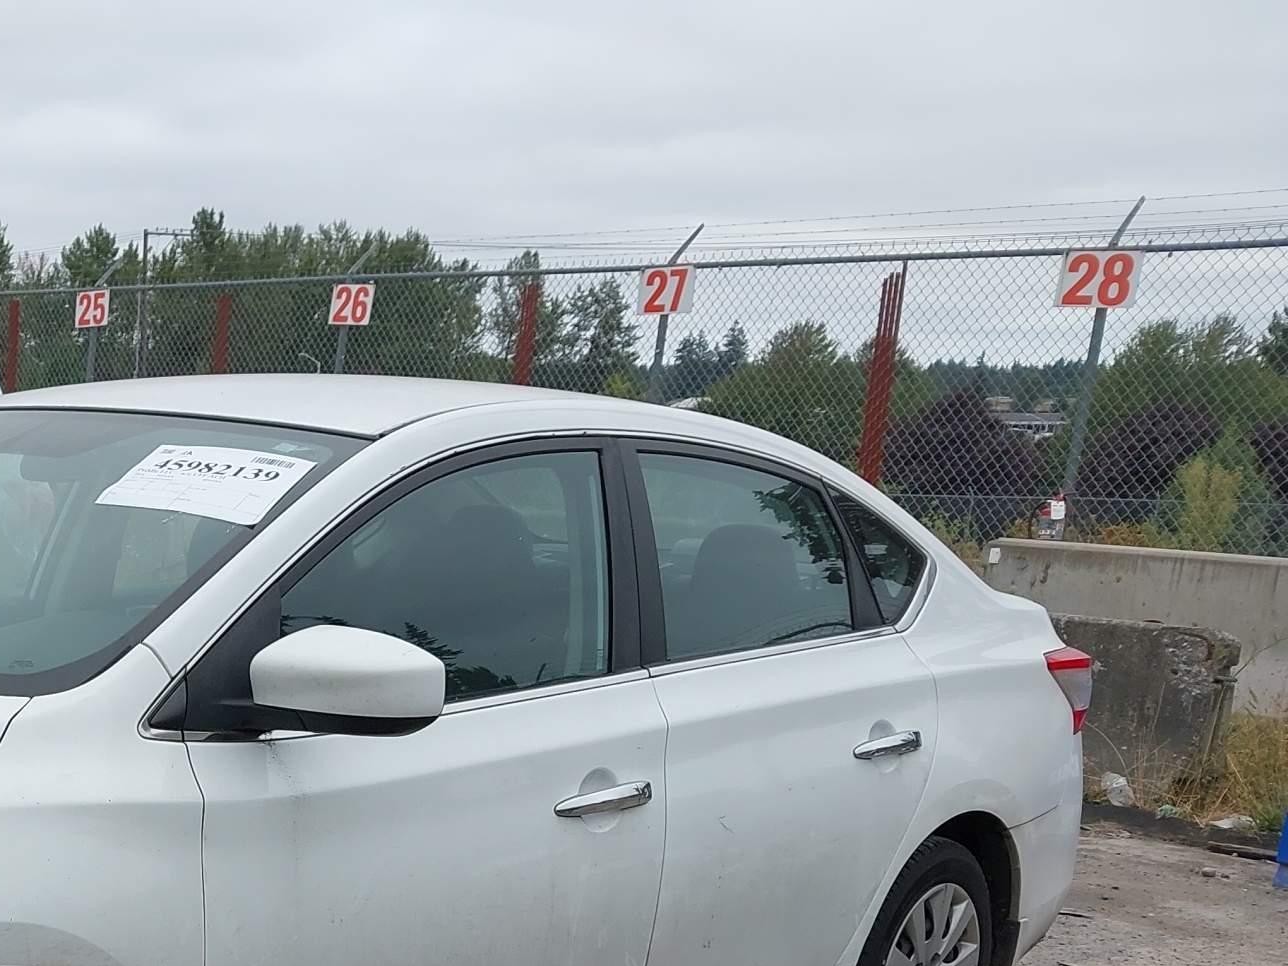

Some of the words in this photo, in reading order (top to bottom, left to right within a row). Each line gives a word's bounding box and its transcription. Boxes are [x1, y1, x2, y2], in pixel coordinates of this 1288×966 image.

[644, 268, 689, 312] 27
[1061, 253, 1134, 306] 28
[78, 292, 106, 325] 25
[332, 286, 369, 323] 26
[154, 459, 281, 482] 45982139
